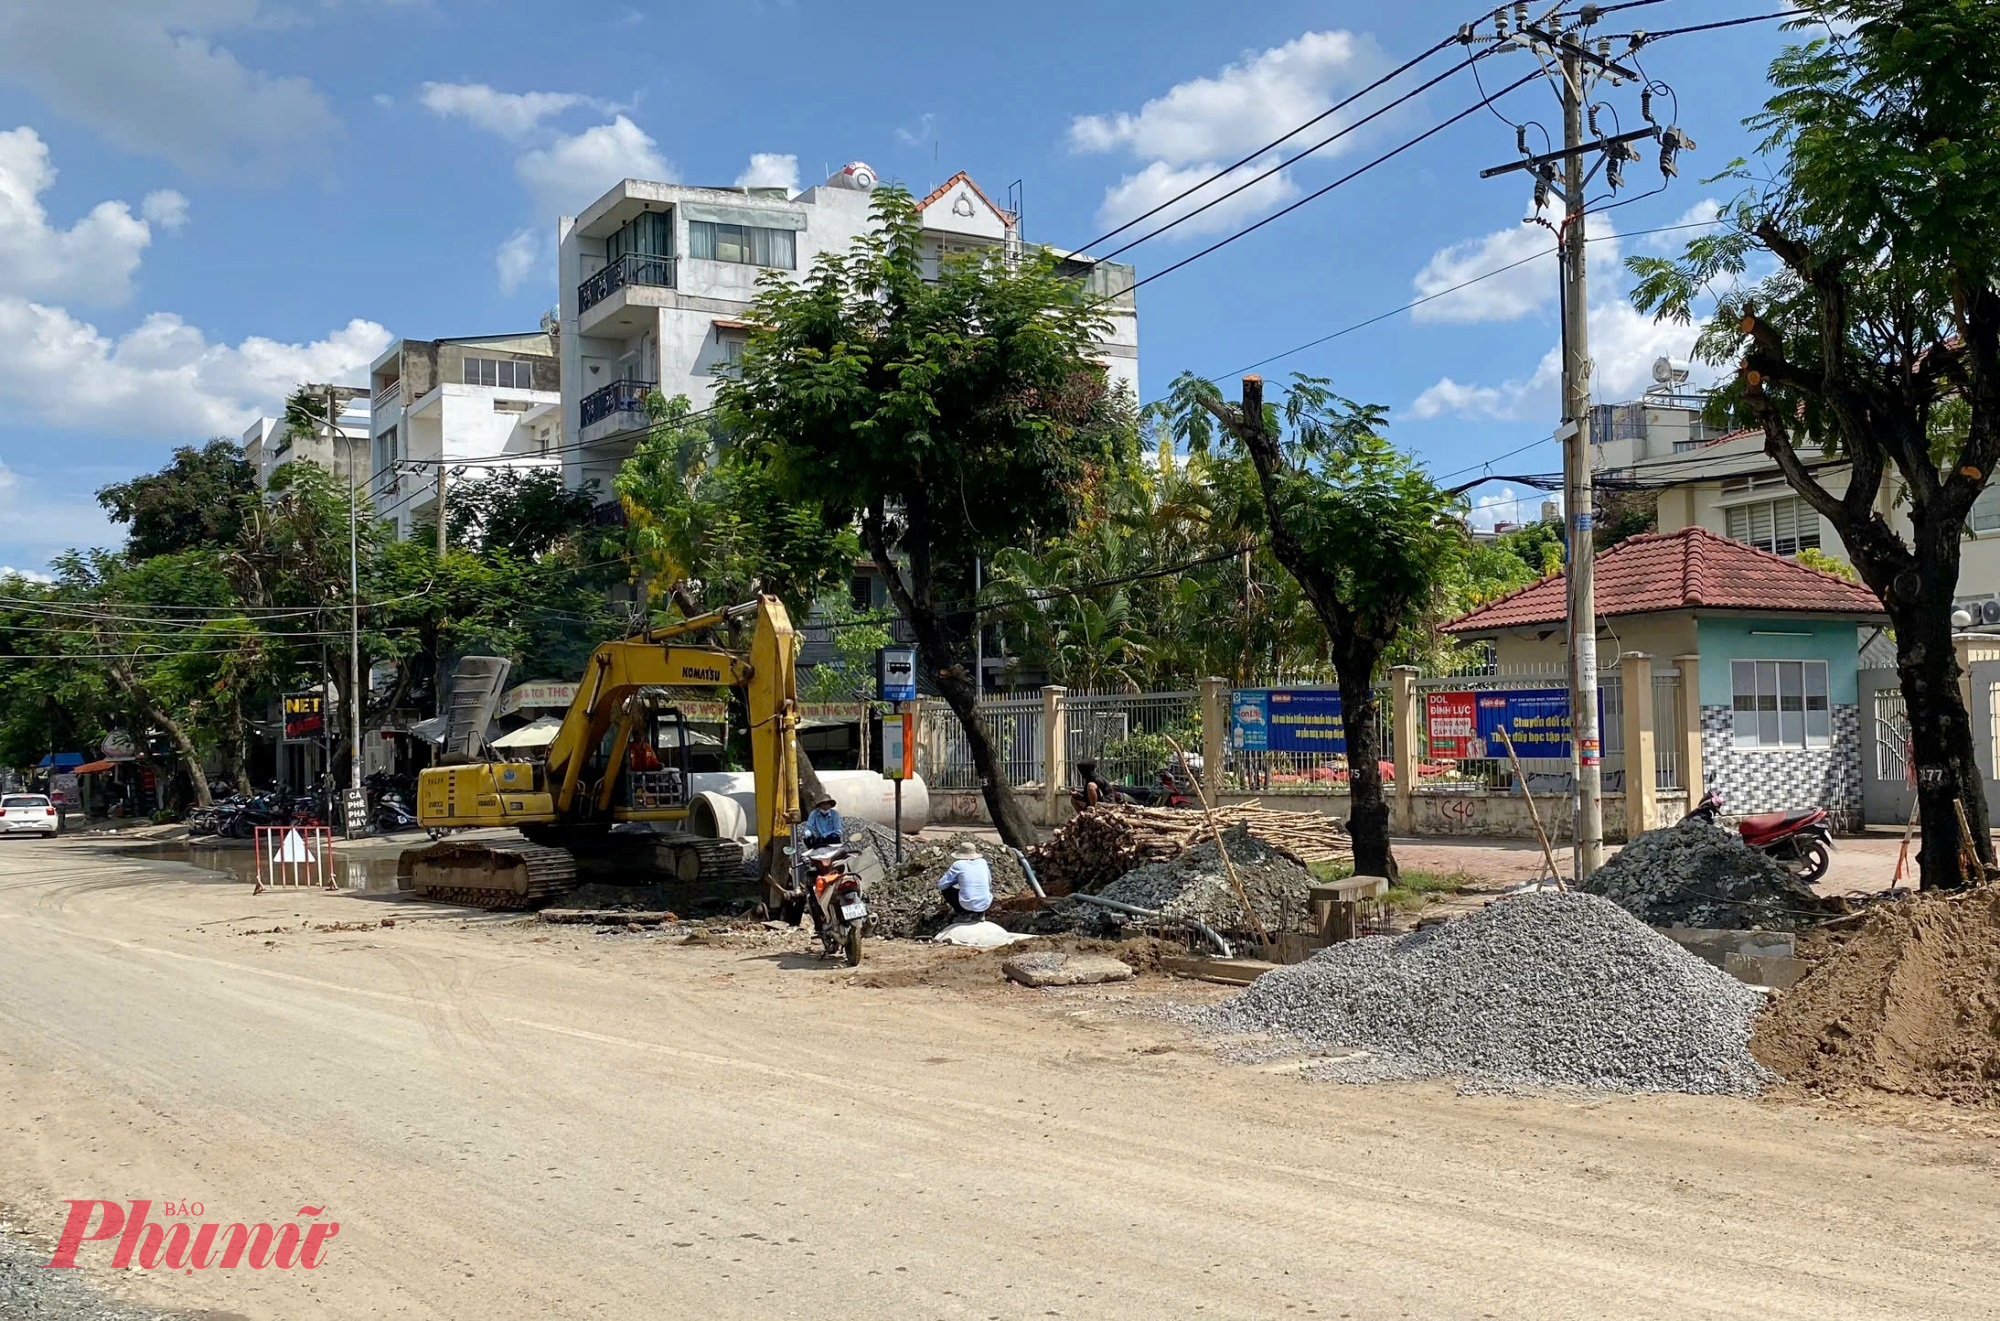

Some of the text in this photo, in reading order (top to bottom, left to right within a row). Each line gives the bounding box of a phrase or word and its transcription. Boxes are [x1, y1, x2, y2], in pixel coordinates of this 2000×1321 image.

[682, 666, 720, 681] KOMATSU
[547, 687, 569, 698] THE
[286, 698, 321, 713] NET
[1430, 695, 1448, 704] DOL
[1430, 704, 1471, 716] ĐÌNH LỰC
[1513, 715, 1544, 728] Chuyển
[1529, 732, 1544, 744] học
[347, 799, 365, 809] PHÊ
[348, 809, 366, 819] PHA
[1442, 800, 1475, 823] C40
